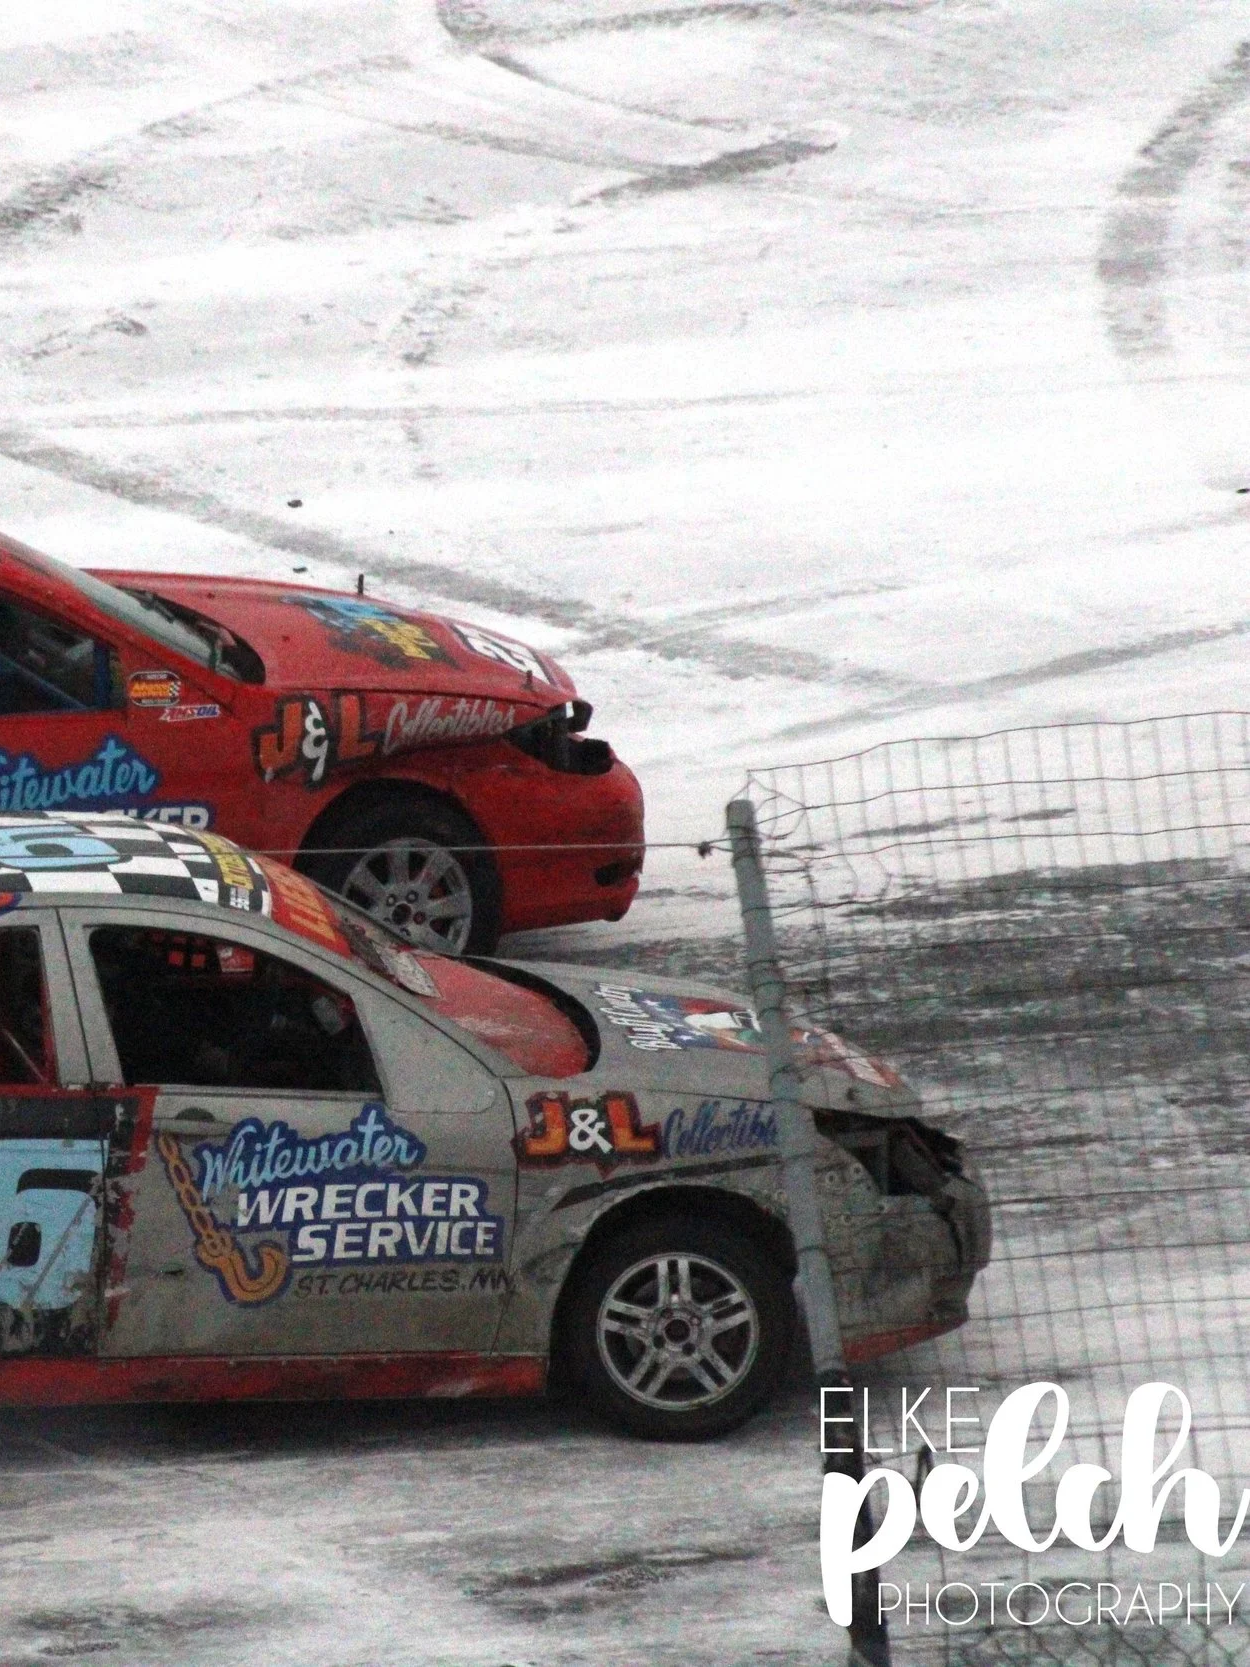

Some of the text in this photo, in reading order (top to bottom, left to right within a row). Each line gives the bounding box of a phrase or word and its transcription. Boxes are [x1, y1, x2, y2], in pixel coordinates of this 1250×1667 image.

[525, 1098, 656, 1156] J&L
[200, 1109, 419, 1202] Whitewater
[238, 1182, 480, 1227] WRECKER
[291, 1220, 497, 1262] SERVICE
